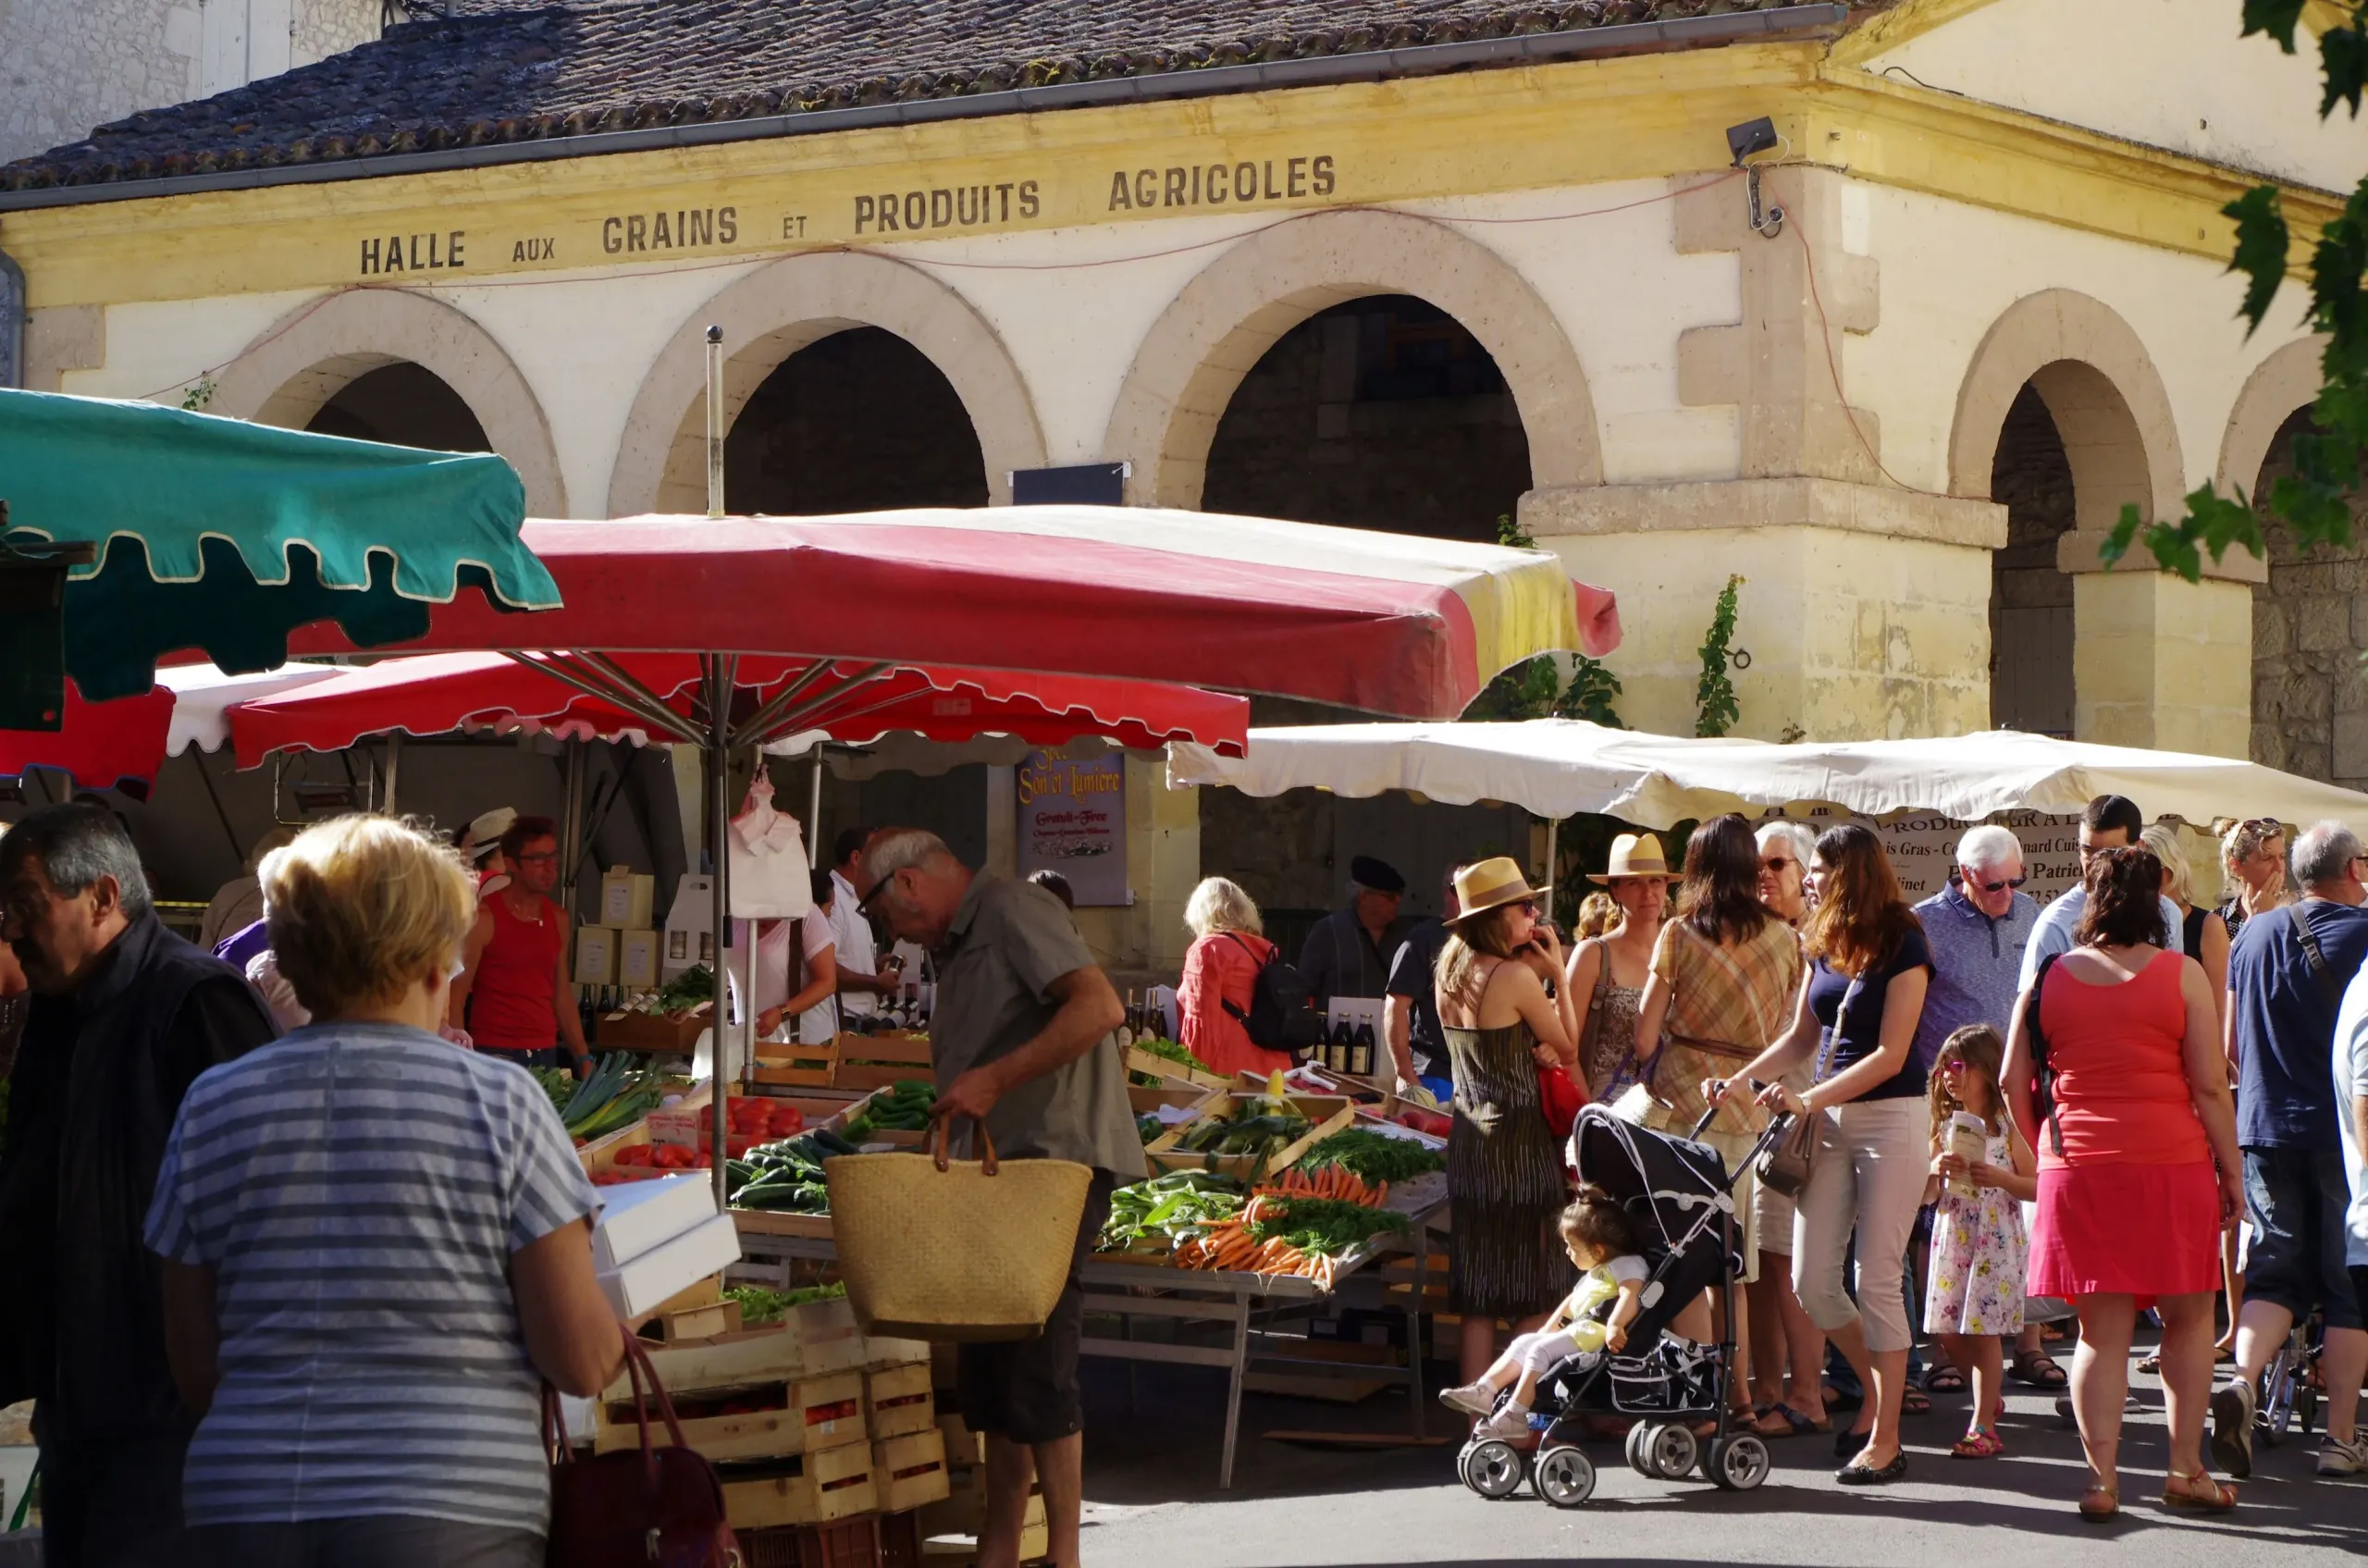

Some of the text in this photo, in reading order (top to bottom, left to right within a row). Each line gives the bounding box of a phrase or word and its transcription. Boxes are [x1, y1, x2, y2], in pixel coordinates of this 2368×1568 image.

[361, 154, 1336, 275] HALLE AUX GRAINS ET PRODUITS AGRICOLES
[1018, 764, 1119, 806] Son et Lumière
[1900, 841, 1930, 856] Gras
[2023, 838, 2052, 854] nard
